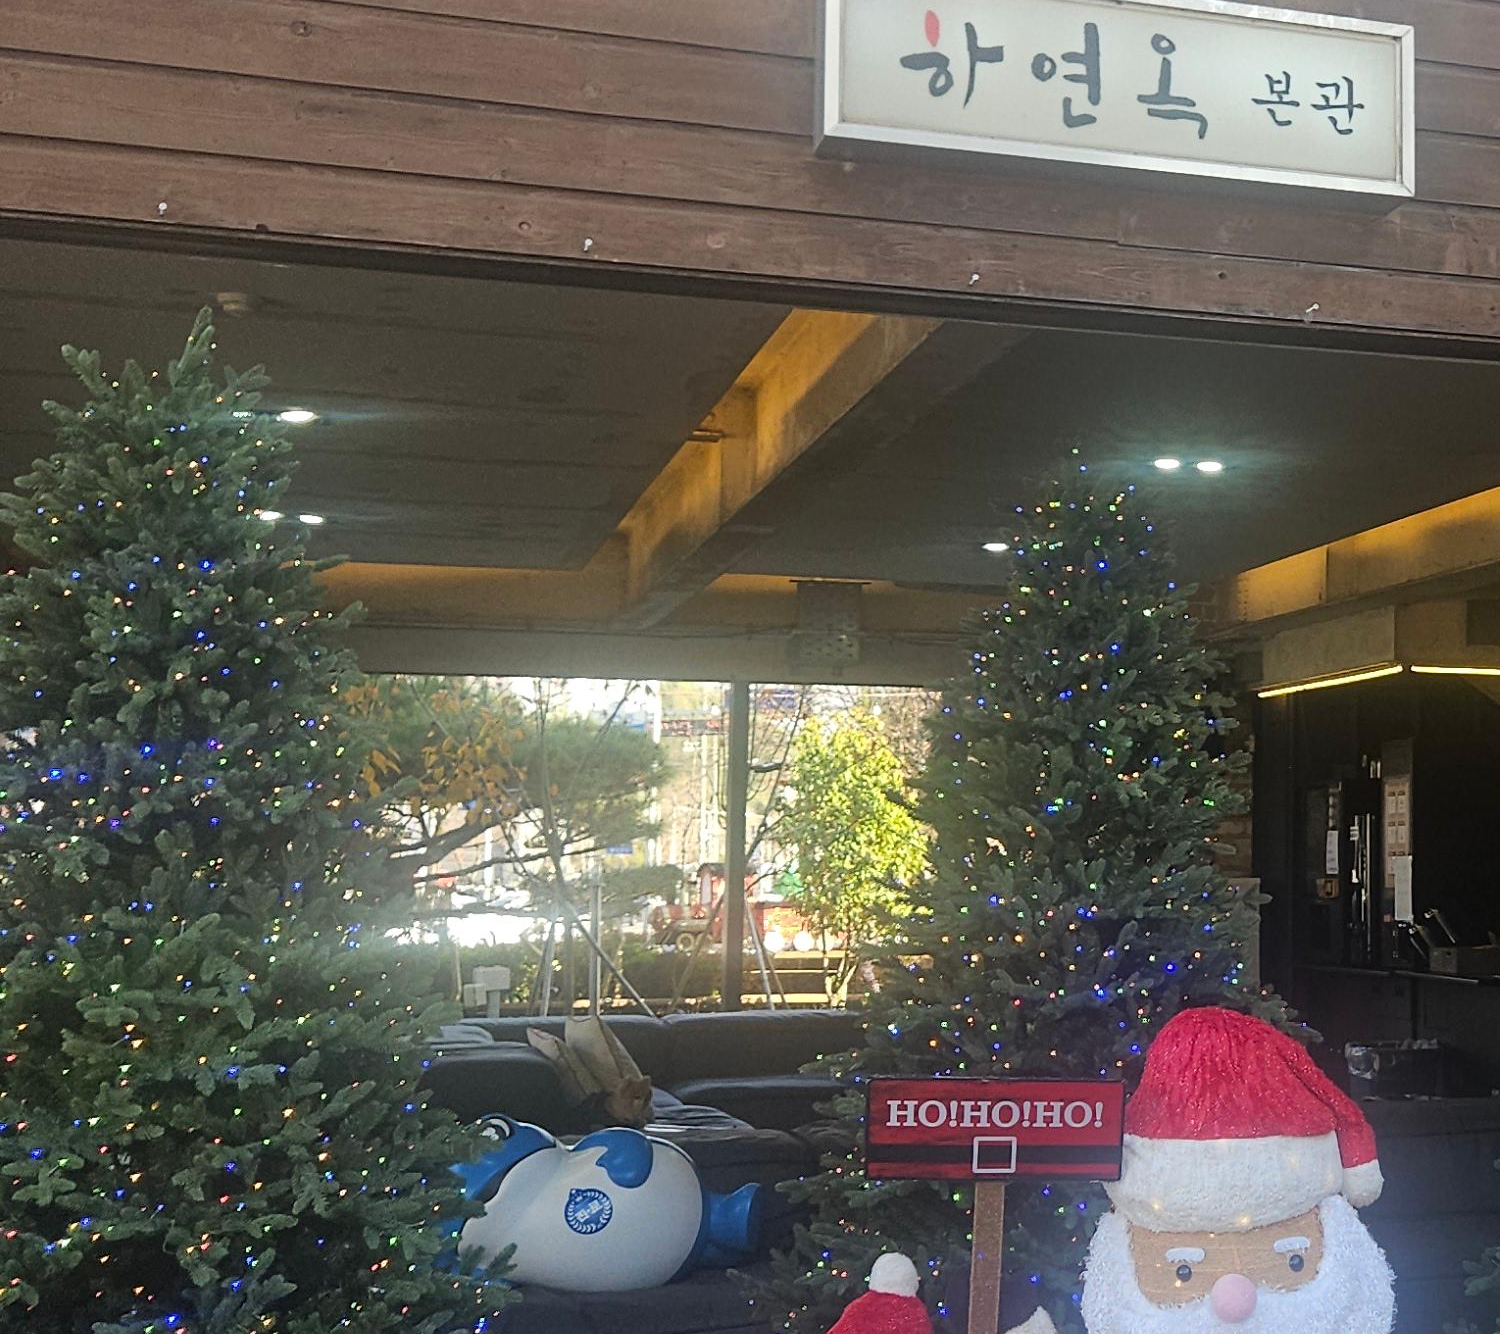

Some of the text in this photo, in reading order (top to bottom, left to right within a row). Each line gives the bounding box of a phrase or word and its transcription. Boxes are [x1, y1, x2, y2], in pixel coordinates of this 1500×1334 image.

[900, 9, 1364, 140] 하연옥 본관
[886, 1099, 1104, 1128] HO!HO!HO!
